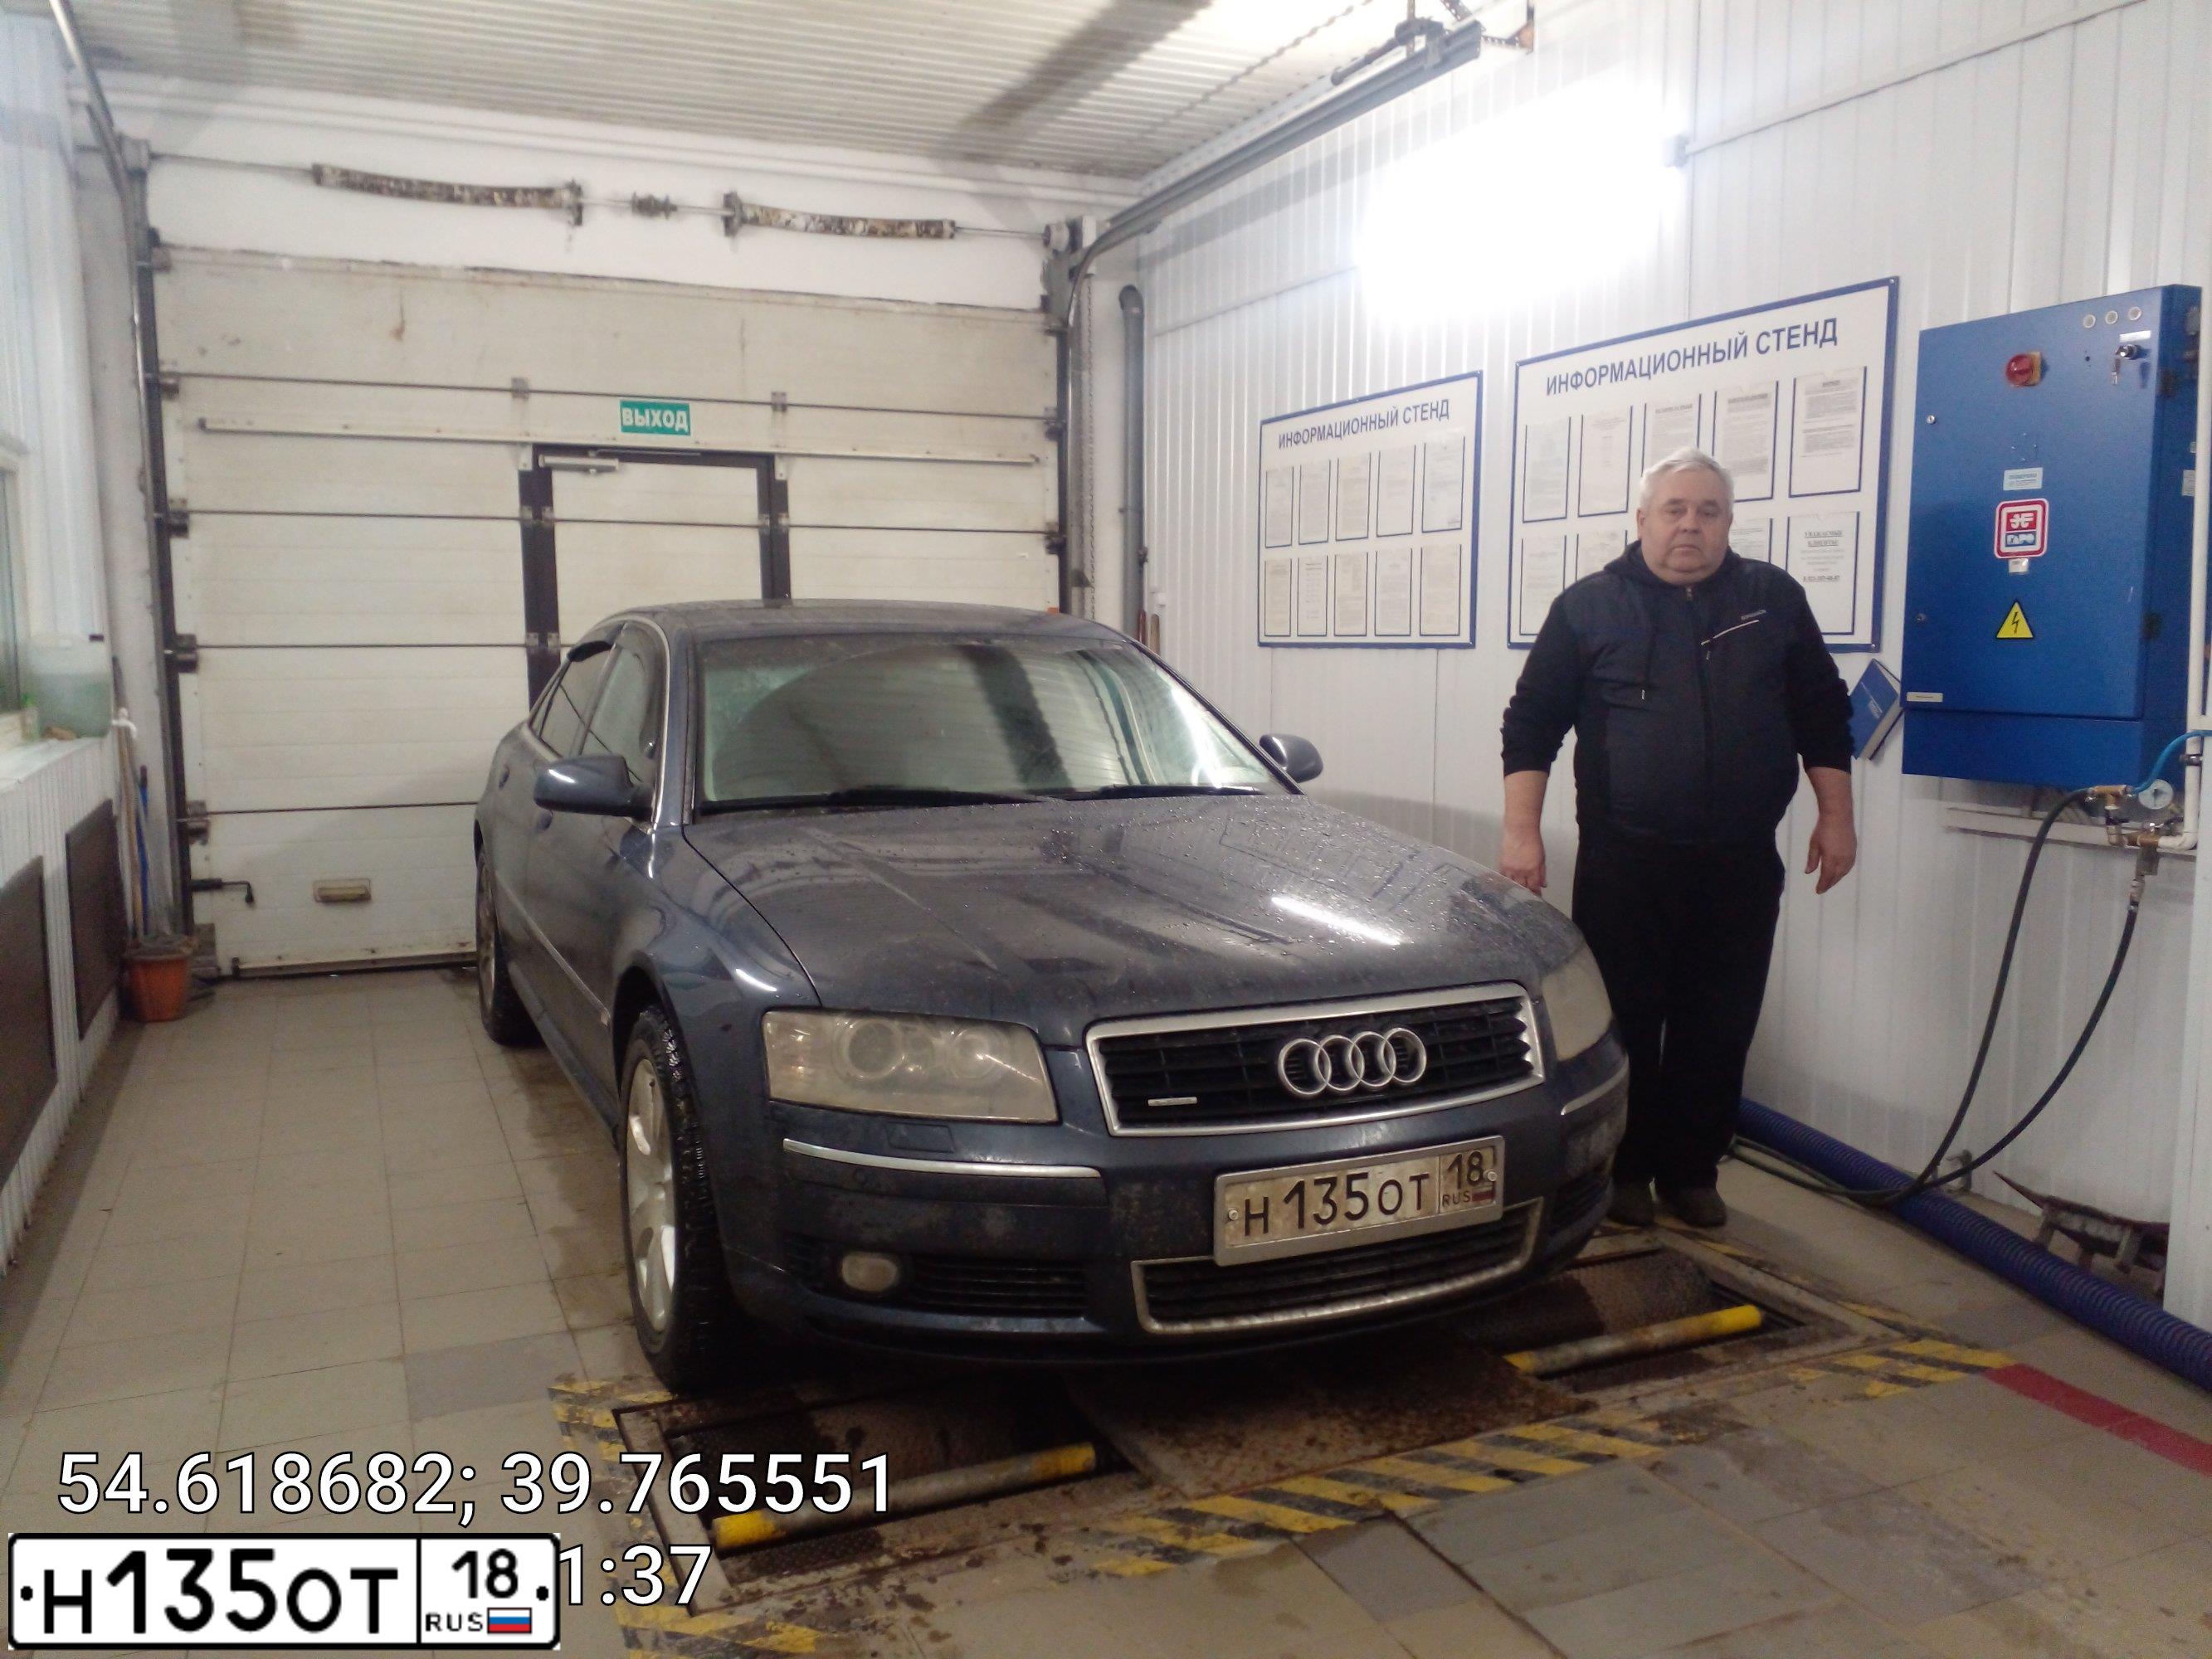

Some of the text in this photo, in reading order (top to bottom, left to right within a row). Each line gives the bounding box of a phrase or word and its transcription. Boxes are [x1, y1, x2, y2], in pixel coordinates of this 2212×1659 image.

[1547, 318, 1838, 396] ИНФОРМАЦИОННЫЙ СТЕНД
[621, 407, 689, 432] ВЫХОД
[1279, 399, 1449, 450] ИНФОРМАЦИОННЫЙ СТЕНД
[1447, 1151, 1484, 1190] 18
[1442, 1190, 1472, 1209] RUS
